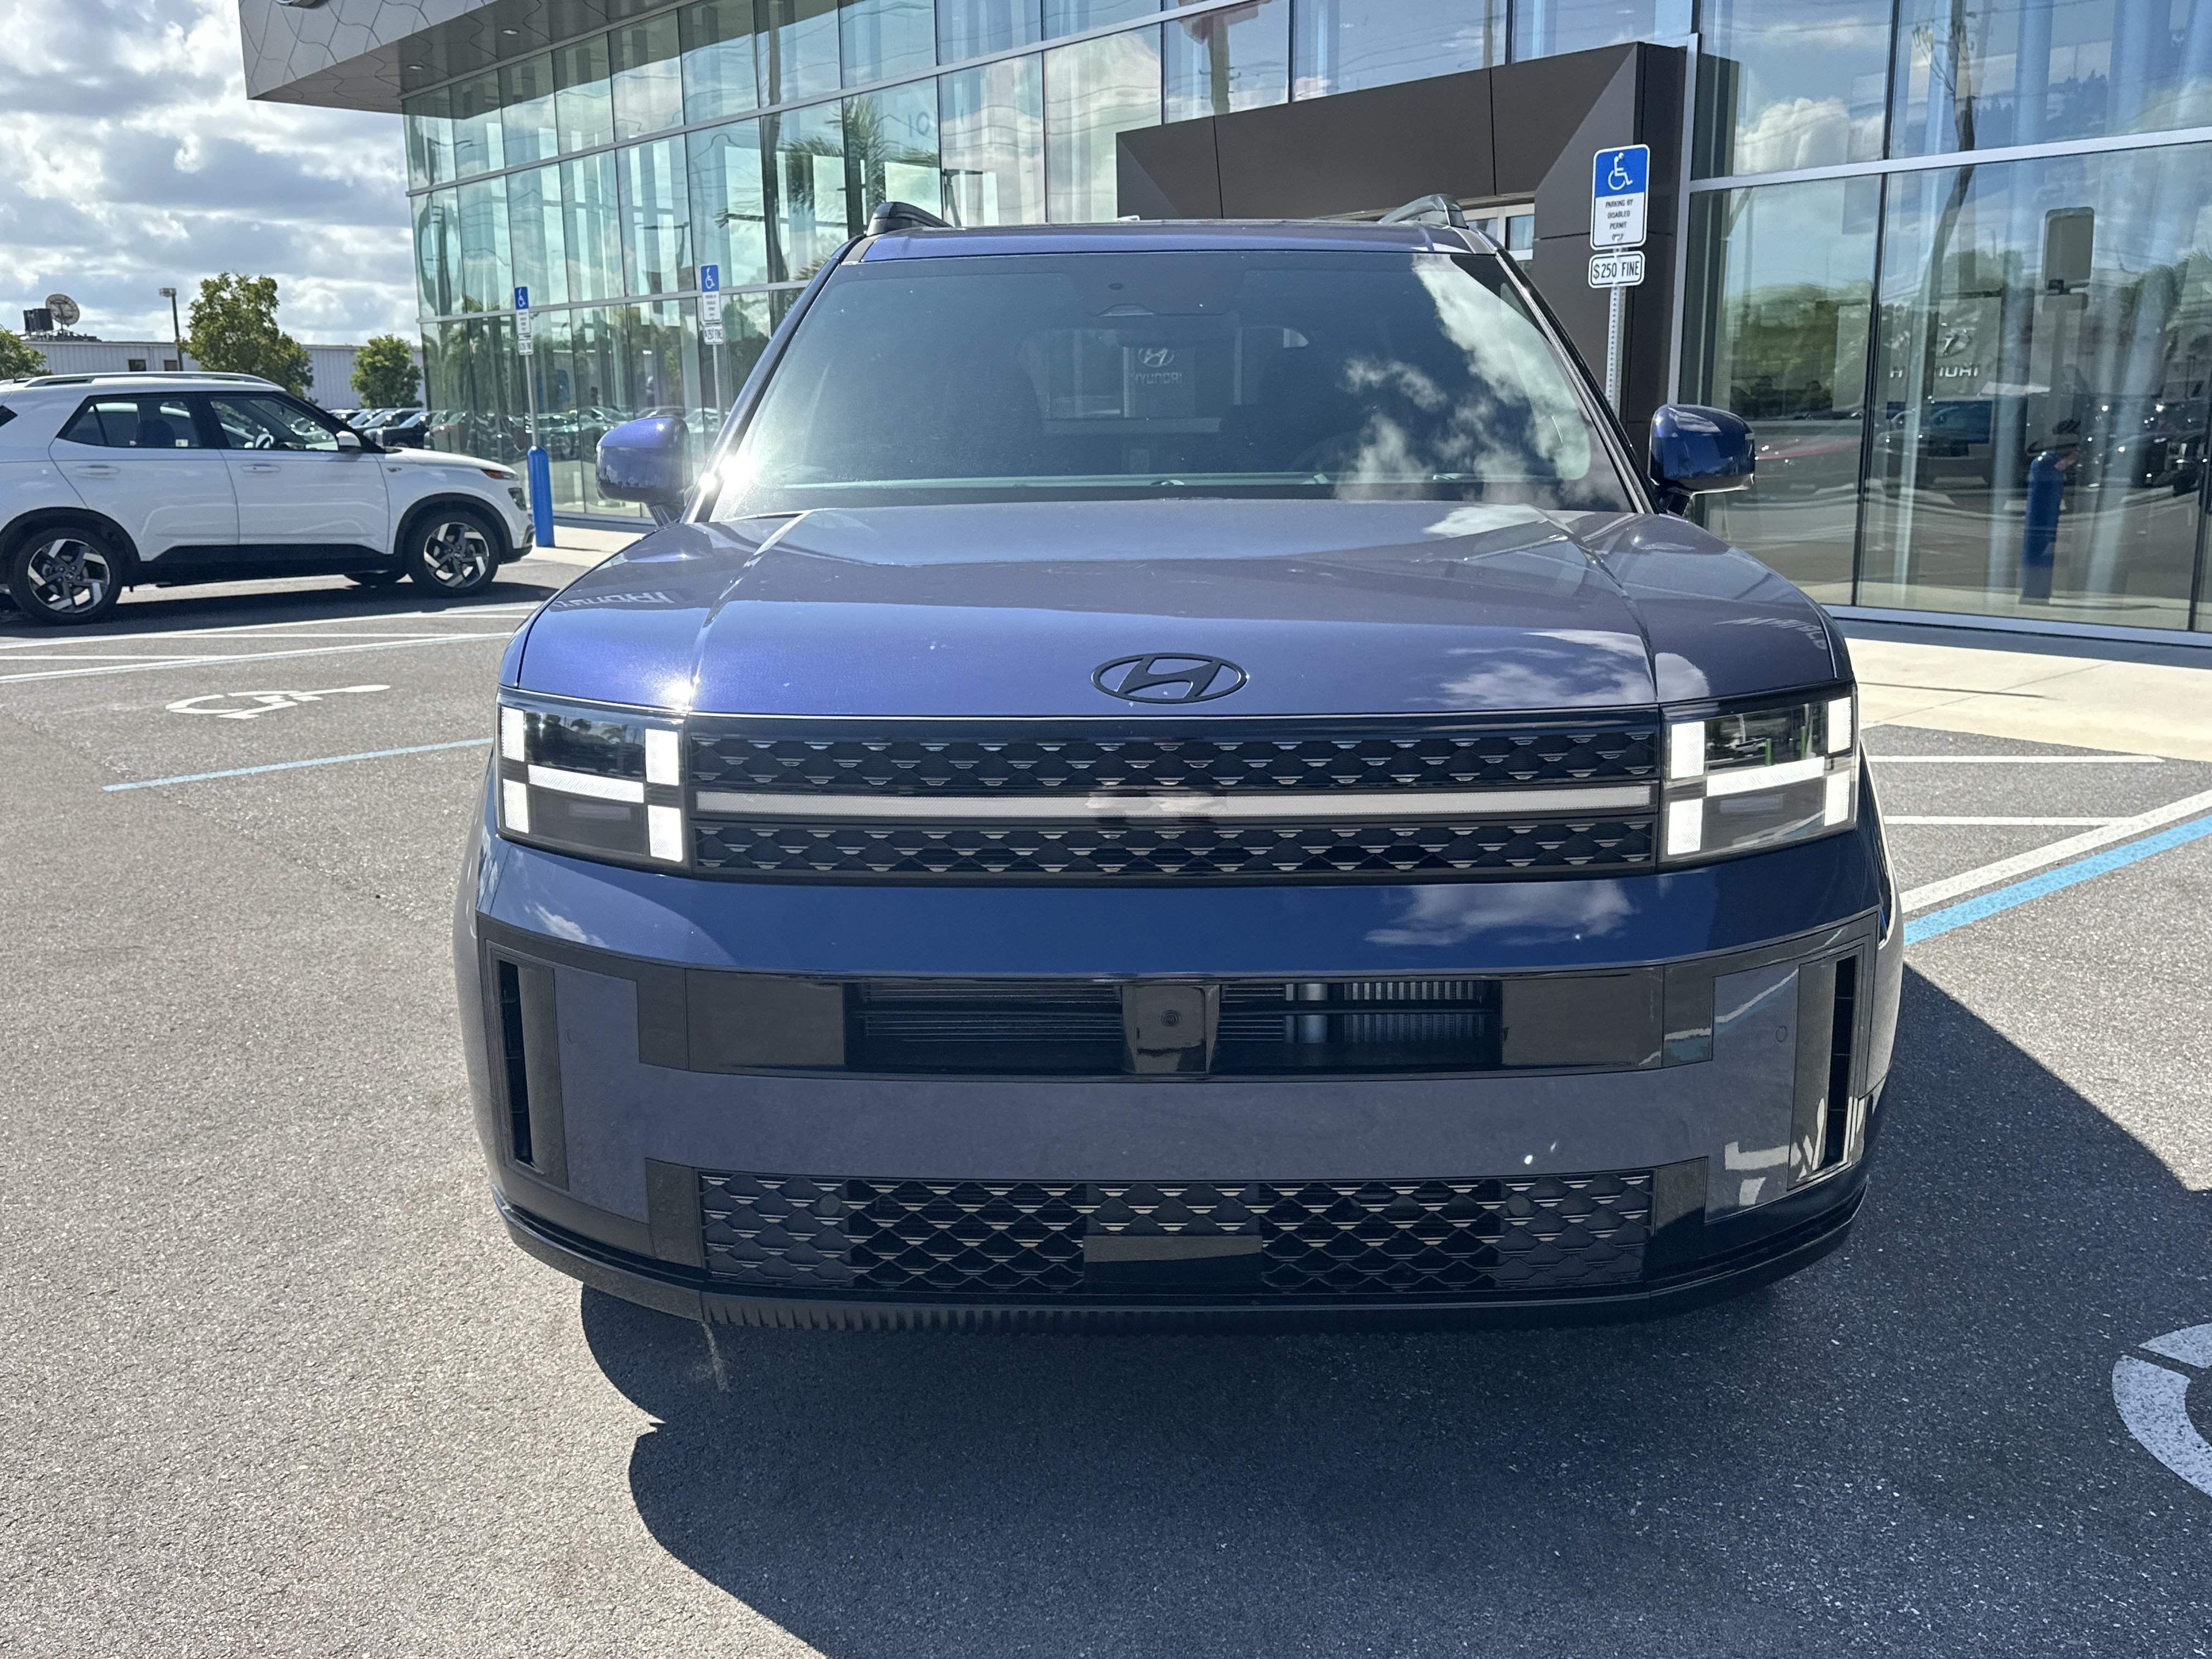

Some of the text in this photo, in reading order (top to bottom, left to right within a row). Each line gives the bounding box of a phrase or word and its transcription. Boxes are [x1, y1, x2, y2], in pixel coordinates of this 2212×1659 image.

[1605, 199, 1625, 208] PARKING
[1607, 210, 1630, 219] DISABLED
[1610, 222, 1627, 230] PERMIT
[1593, 260, 1640, 280] $250 FINE
